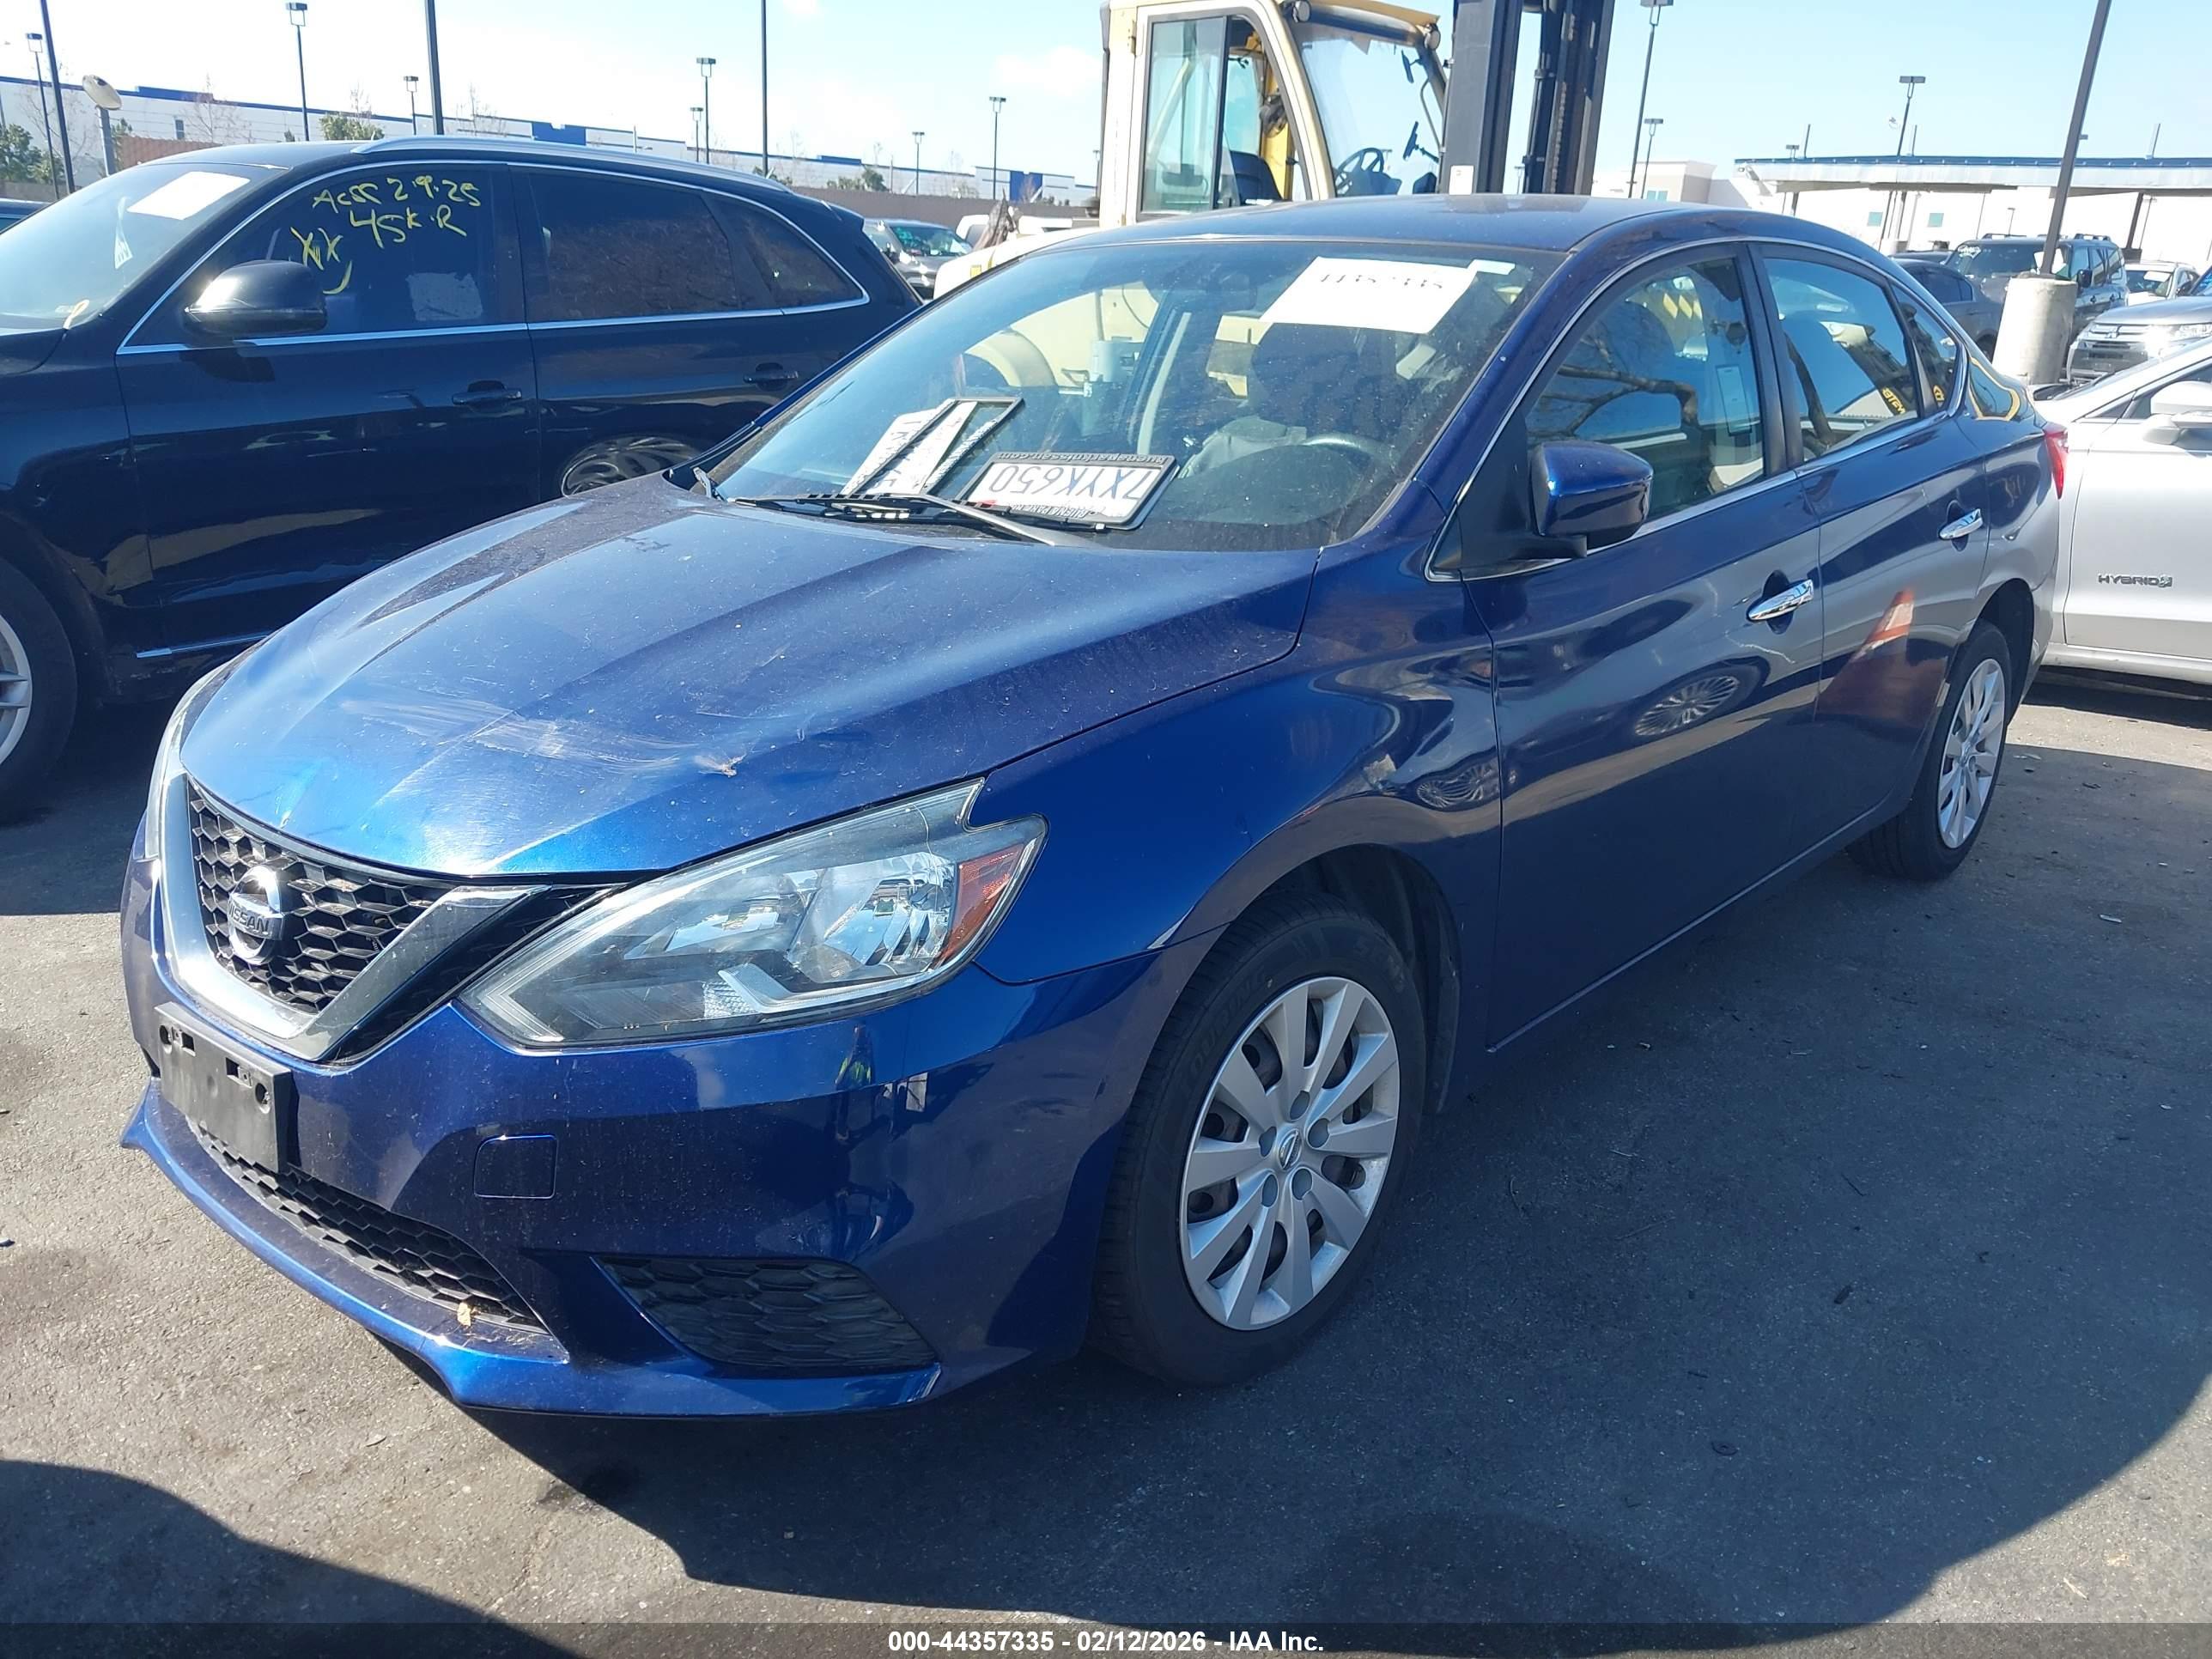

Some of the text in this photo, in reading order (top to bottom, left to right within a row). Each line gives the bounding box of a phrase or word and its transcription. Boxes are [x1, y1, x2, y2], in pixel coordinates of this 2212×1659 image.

[988, 465, 1152, 500] 7XYK650
[2098, 574, 2160, 586] HYBRID
[228, 899, 270, 933] NISSAN
